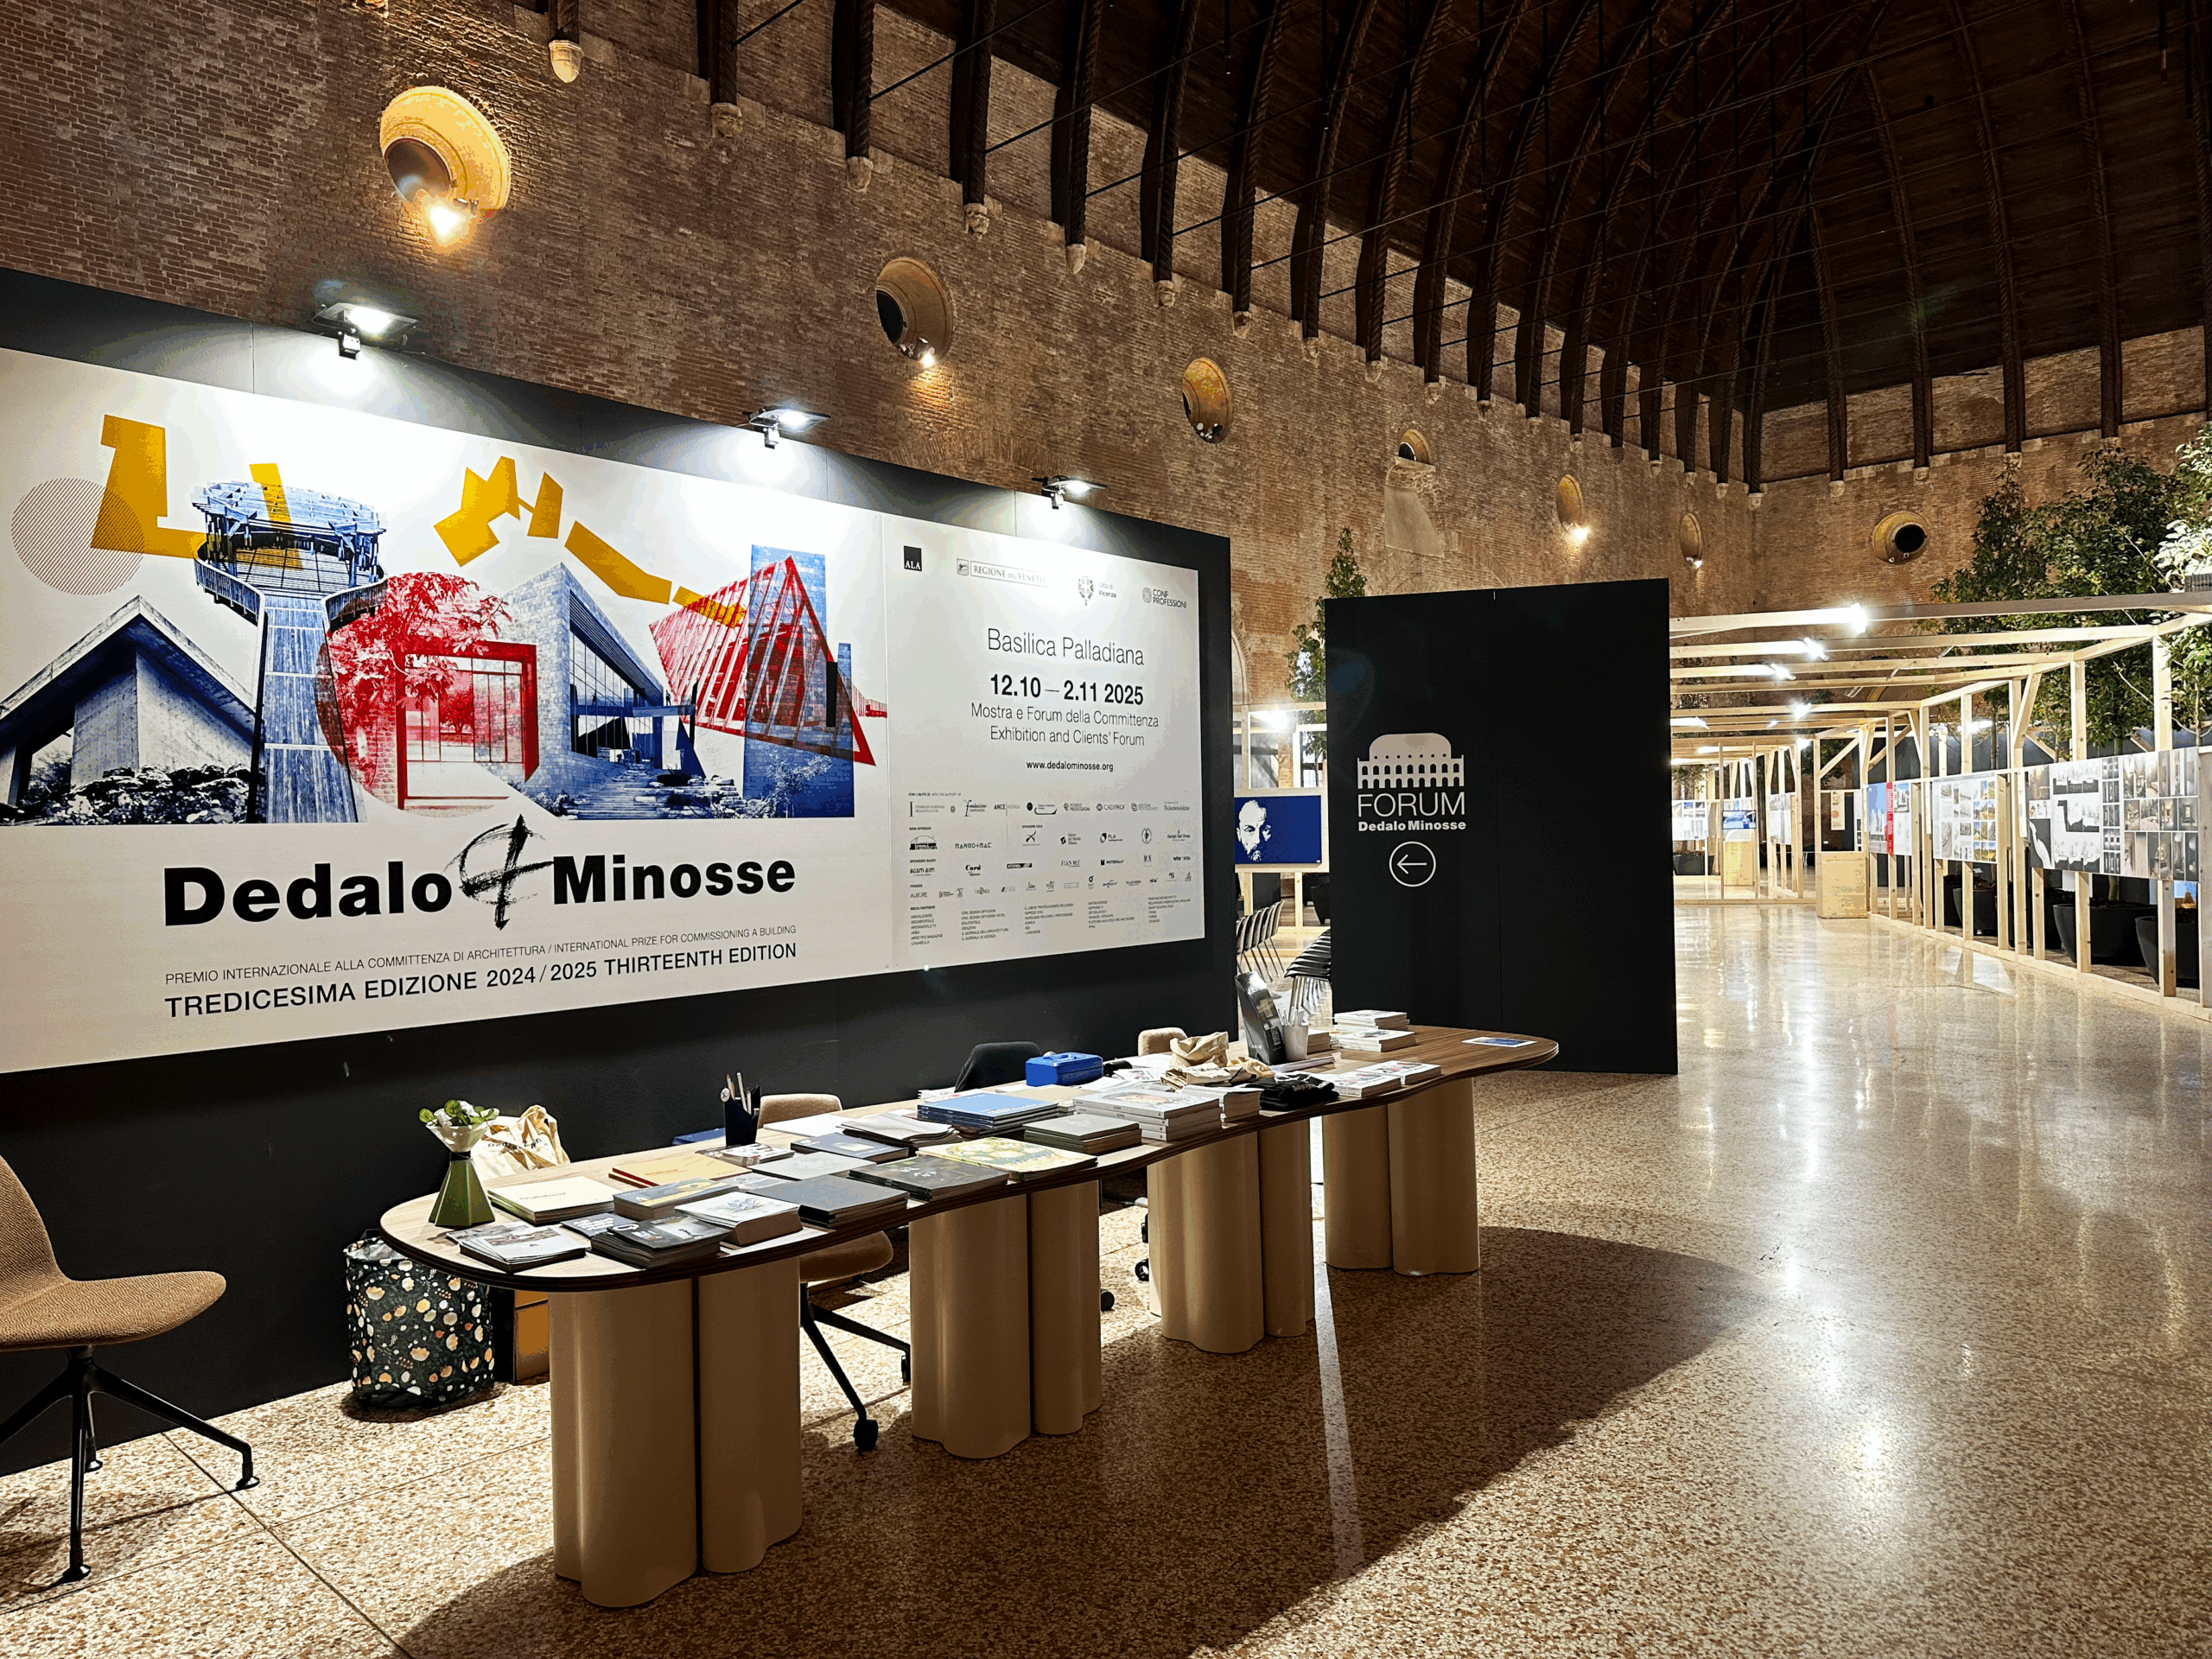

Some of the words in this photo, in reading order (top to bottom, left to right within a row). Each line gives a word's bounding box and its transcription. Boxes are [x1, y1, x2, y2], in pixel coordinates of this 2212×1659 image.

[905, 560, 922, 570] ALA
[974, 564, 1006, 578] REGIONE
[1098, 589, 1116, 599] Vicenza
[1153, 588, 1169, 598] CONF
[1153, 597, 1187, 609] PROFESSIONI
[988, 627, 1056, 657] Basilica
[1062, 636, 1145, 666] Palladiana
[990, 673, 1041, 698] 12.10
[1064, 679, 1097, 702] 2.11
[1104, 683, 1144, 705] 2025
[971, 702, 1013, 720] Mostra
[1016, 709, 1024, 720] e
[1027, 706, 1063, 722] Forum
[1065, 709, 1091, 724] della
[1093, 710, 1159, 728] Committenza
[990, 725, 1046, 742] Exhibition
[1049, 729, 1070, 743] and
[1113, 731, 1145, 747] Forum
[1026, 760, 1114, 772] www.dedalominosse.org
[1357, 791, 1465, 817] FORUM
[1357, 820, 1407, 832] Dedalo
[1408, 819, 1466, 831] Minosse
[163, 860, 453, 927] Dedalo
[552, 853, 796, 906] Minosse
[165, 969, 219, 985] PREMIO
[222, 961, 331, 981] INTERNAZIONALE
[334, 958, 365, 971] ALLA
[367, 951, 450, 969] COMMITTENZA
[454, 951, 465, 962] DI
[467, 944, 546, 962] ARCHITETTURA
[554, 938, 630, 953] INTERNATIONAL
[631, 936, 658, 948] PRIZE
[659, 934, 679, 944] FOR
[680, 929, 750, 944] COMMISSIONING
[751, 927, 759, 938] A
[760, 925, 797, 937] BUILDING
[165, 982, 356, 1018] TREDICESIMA
[365, 970, 478, 999] EDIZIONE
[604, 948, 722, 976] THIRTEENTH
[728, 942, 797, 963] EDITION
